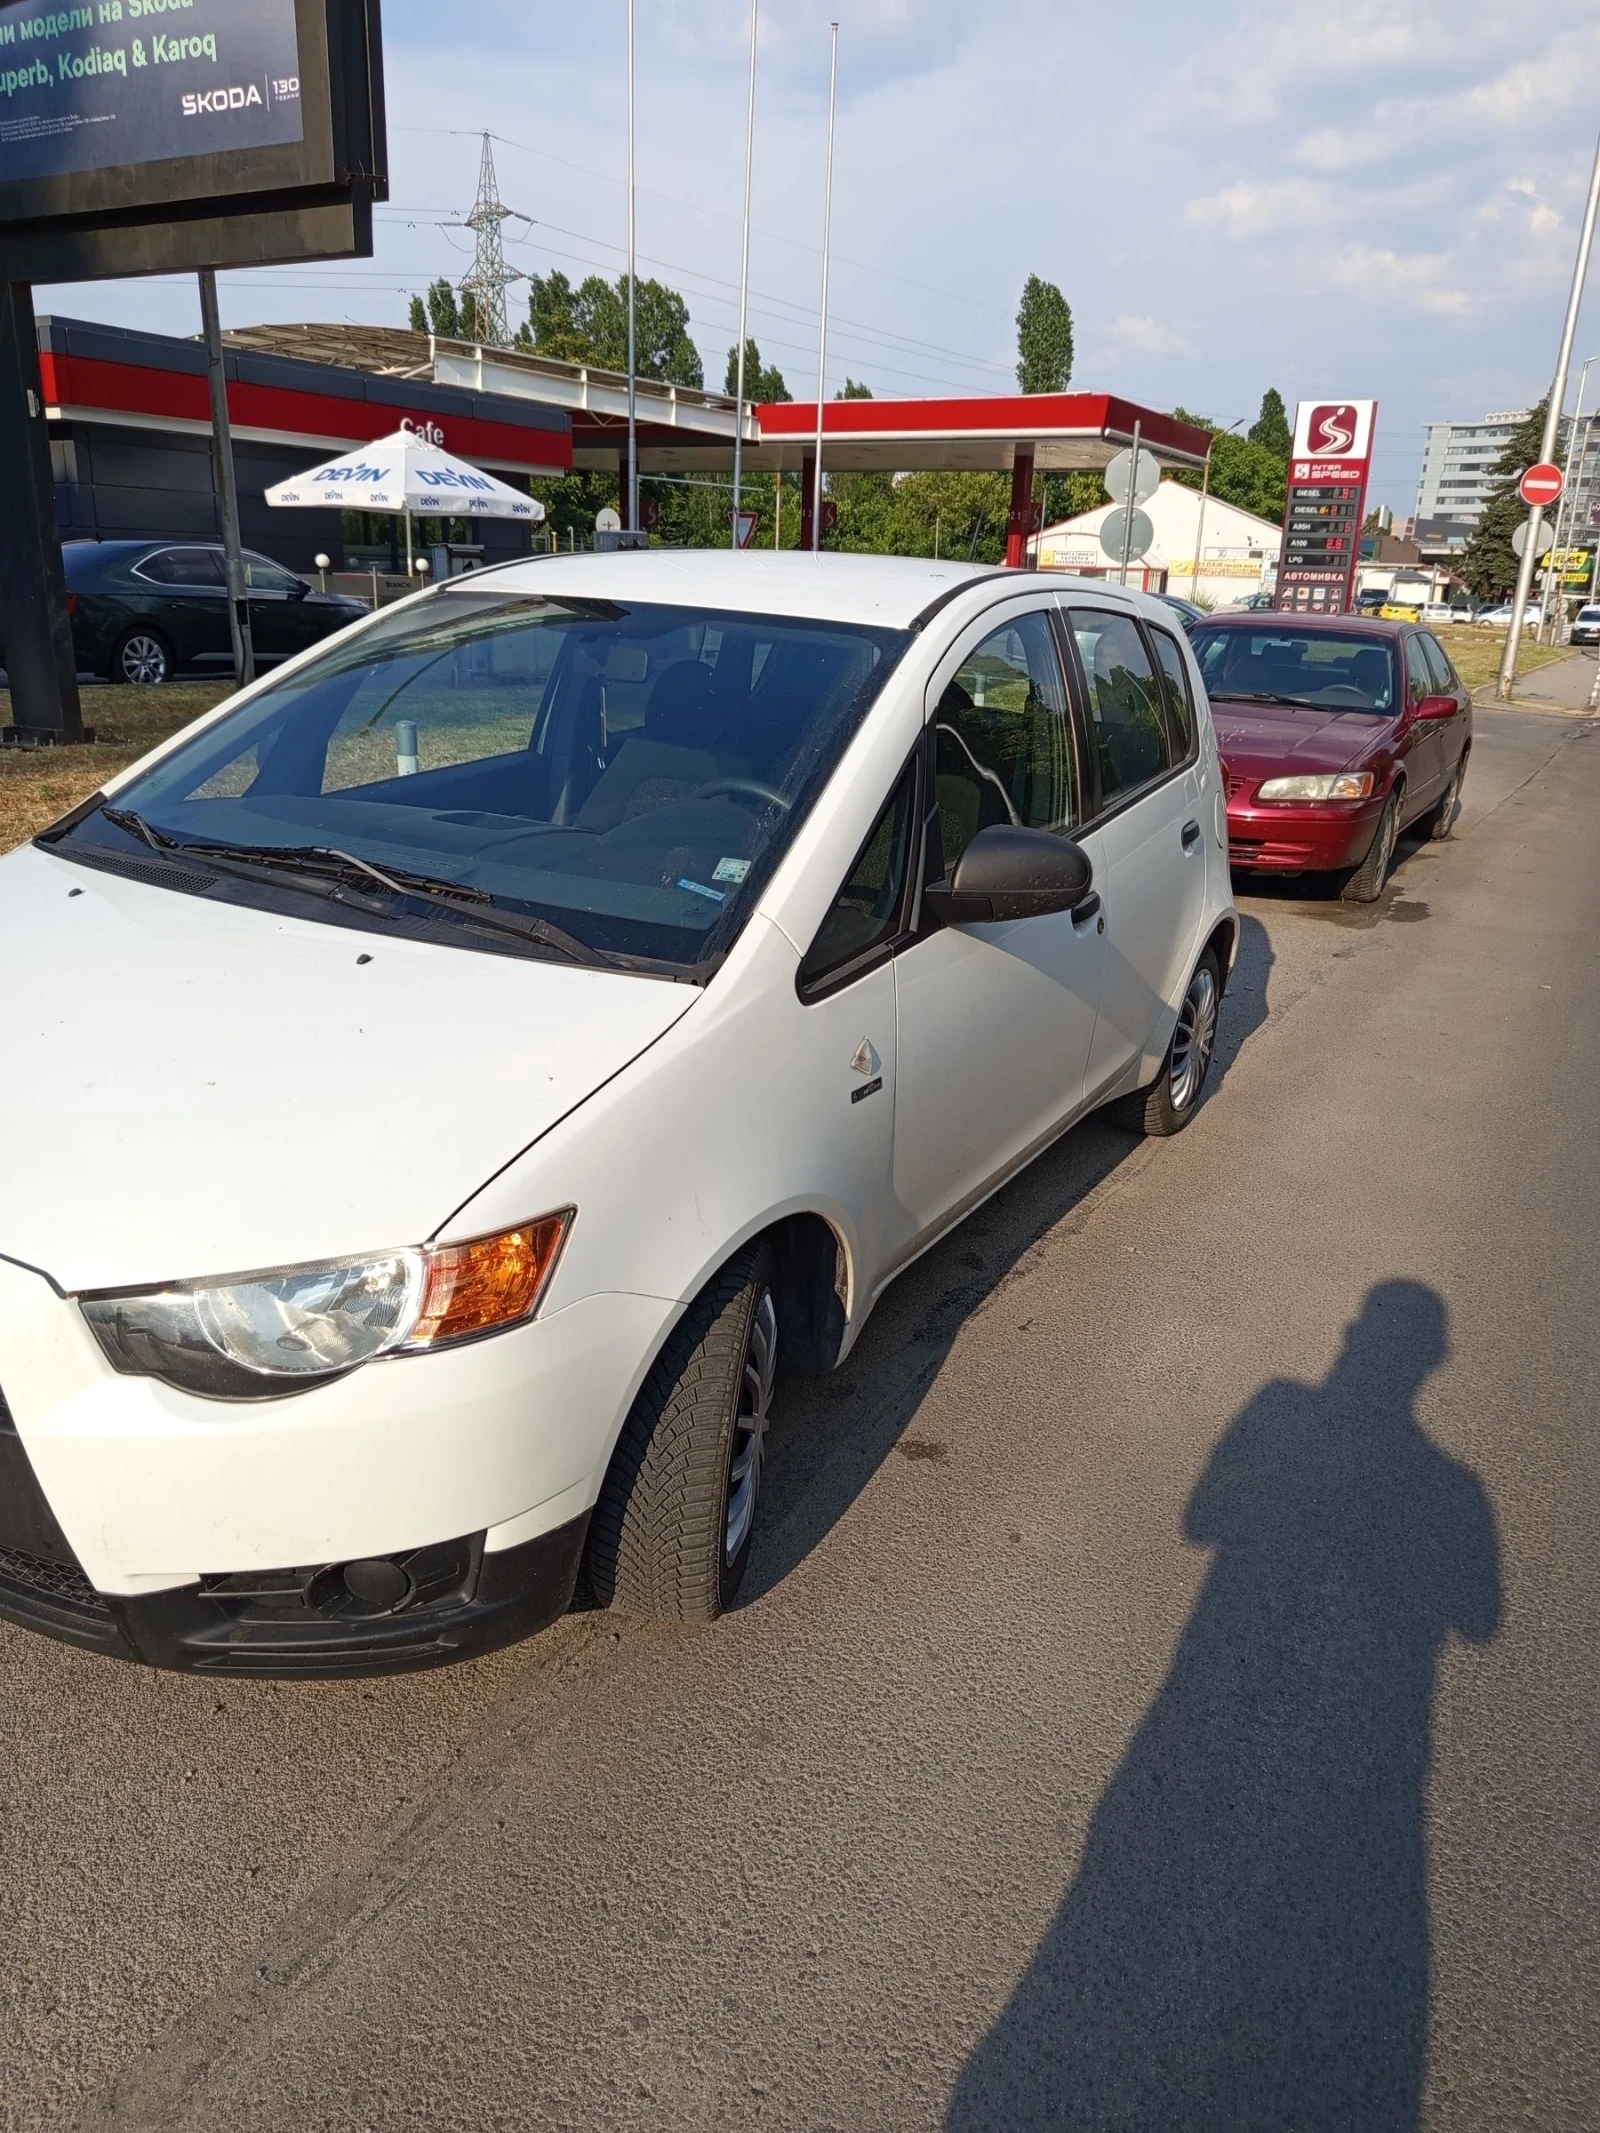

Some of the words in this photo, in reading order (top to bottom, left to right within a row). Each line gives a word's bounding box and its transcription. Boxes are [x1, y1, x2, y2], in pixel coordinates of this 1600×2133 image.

[20, 7, 93, 41] модели
[99, 1, 122, 24] на
[58, 46, 128, 77] Kodiaq
[132, 38, 148, 67] &
[153, 32, 217, 64] Karoq
[272, 77, 299, 95] 130
[400, 417, 445, 444] Cafe
[312, 463, 391, 481] DEVIN
[1311, 471, 1360, 479] SPEED
[415, 467, 496, 491] DEVIN
[281, 492, 300, 501] DEVIN
[324, 490, 343, 500] DEVIN
[370, 492, 389, 502] DEVIN
[1296, 489, 1321, 497] DIESEL
[420, 496, 439, 506] DEVIN
[468, 496, 488, 508] DEVIN
[512, 503, 531, 513] DEVIN
[1290, 539, 1308, 547] A100
[1283, 572, 1344, 582] АВТОМИВКА
